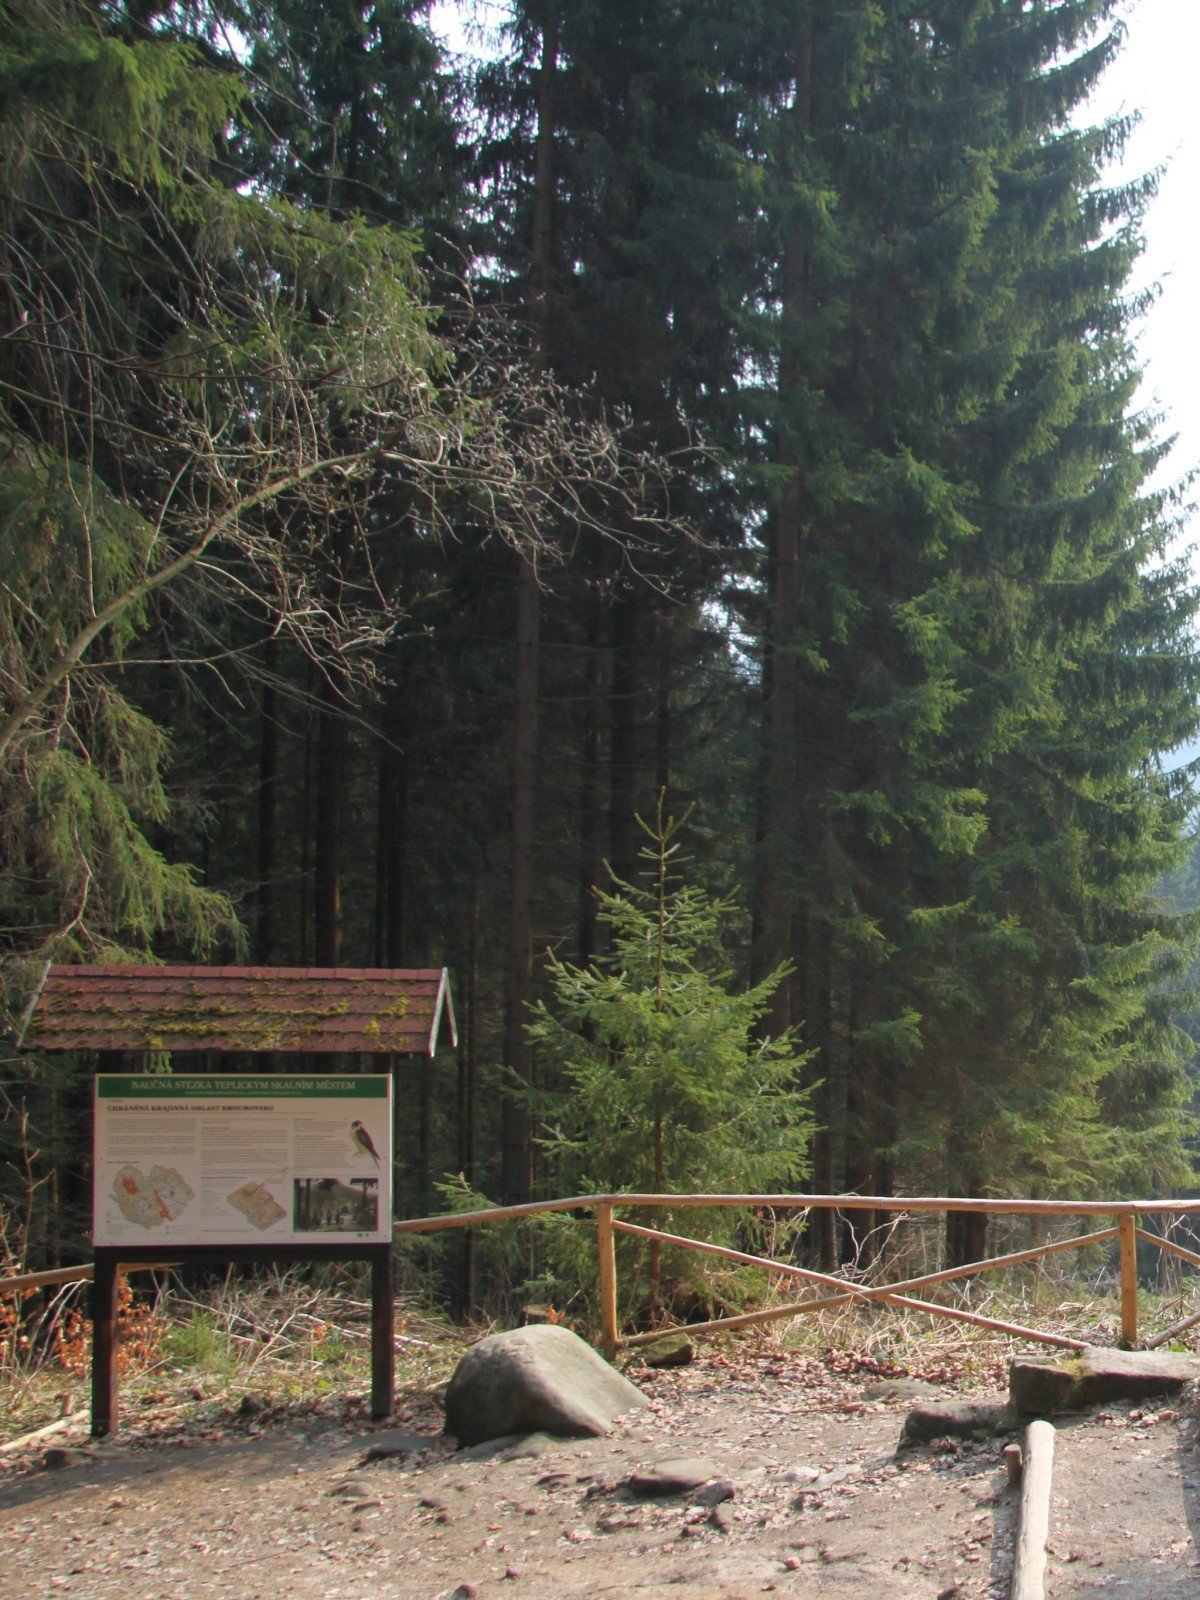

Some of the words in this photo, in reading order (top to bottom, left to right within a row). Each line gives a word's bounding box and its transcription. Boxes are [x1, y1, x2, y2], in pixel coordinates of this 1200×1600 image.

[131, 1079, 173, 1090] NAUČNÁ
[175, 1080, 212, 1090] STEZKA
[214, 1079, 269, 1090] TEPLICKÝM
[190, 1104, 220, 1112] OBLAST
